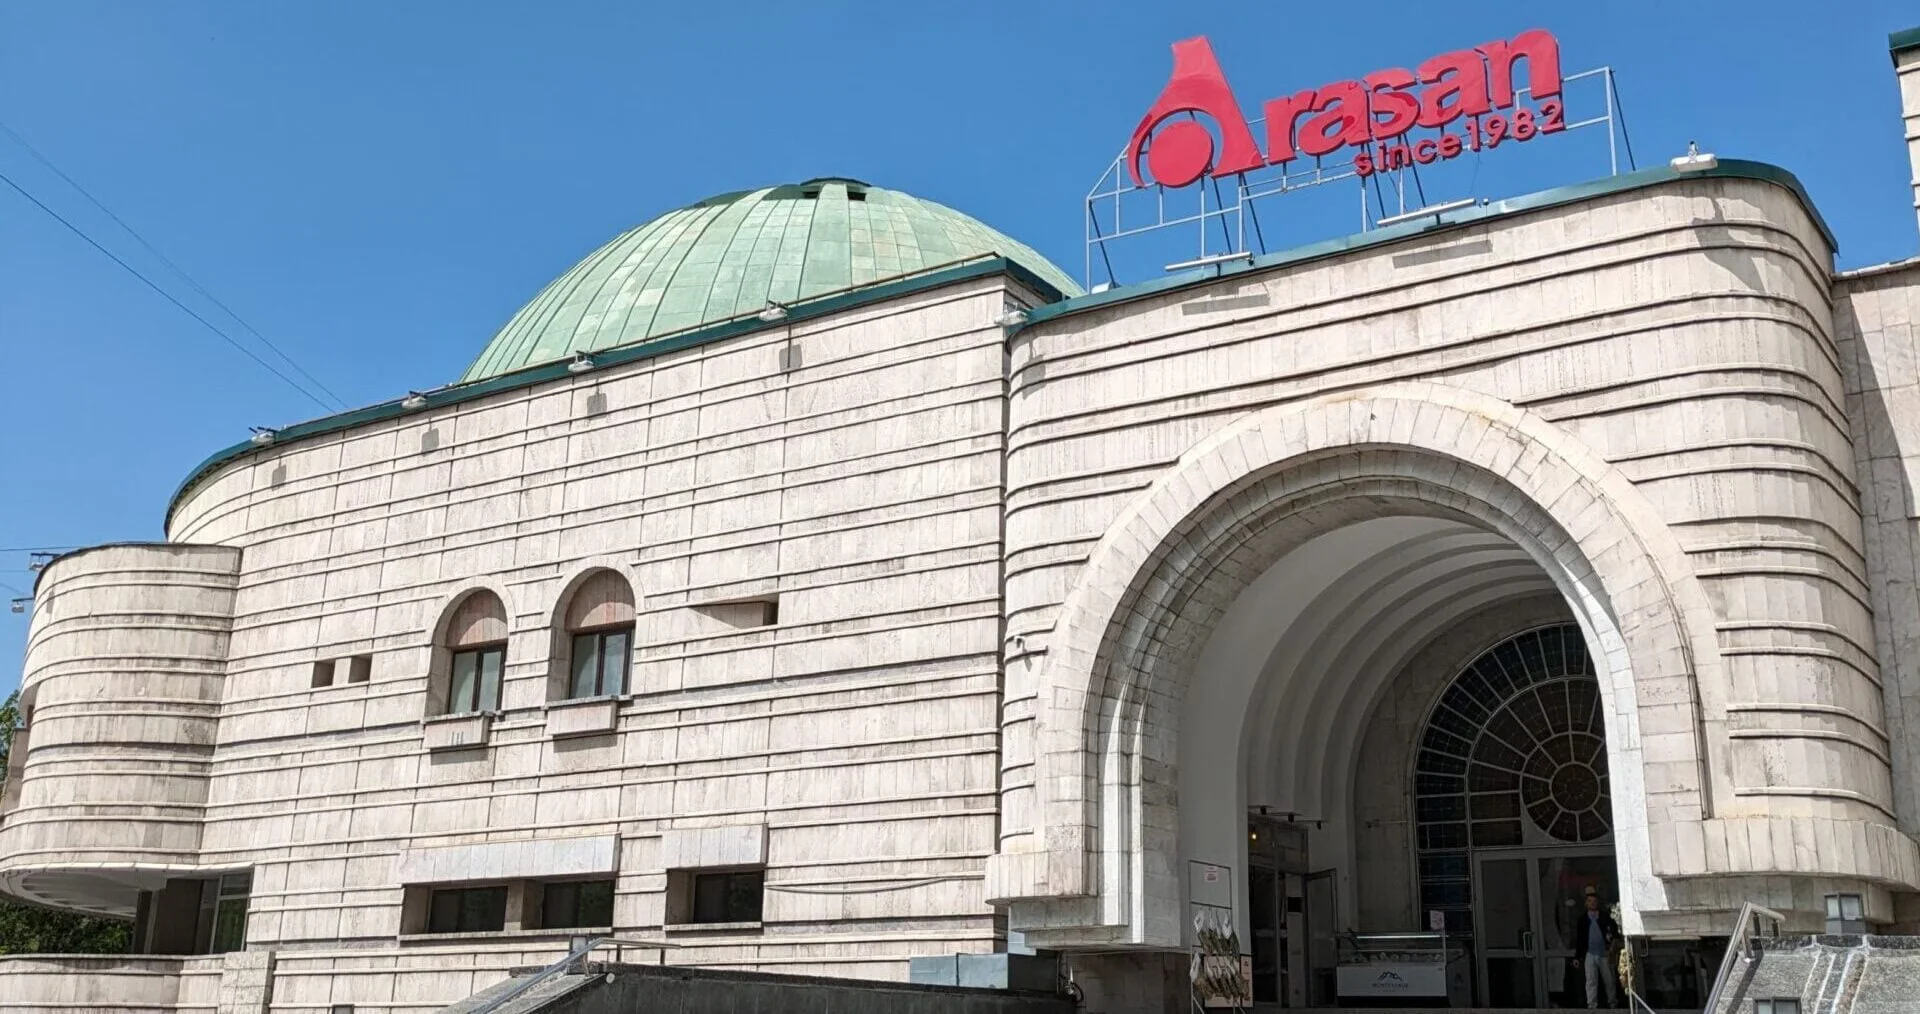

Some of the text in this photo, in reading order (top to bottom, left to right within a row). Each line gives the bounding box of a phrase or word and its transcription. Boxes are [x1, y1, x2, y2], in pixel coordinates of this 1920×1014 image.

[1127, 29, 1561, 188] Arasan
[1354, 101, 1566, 176] since 1982
